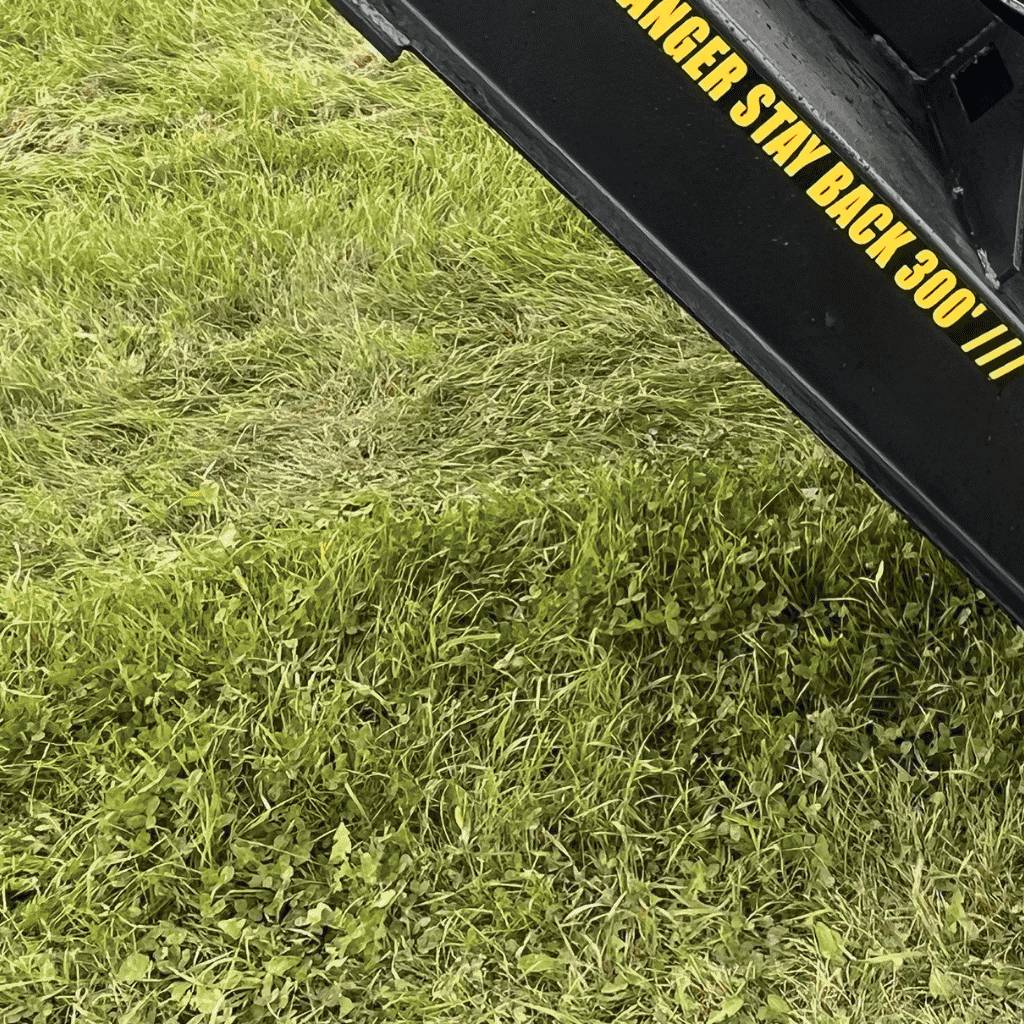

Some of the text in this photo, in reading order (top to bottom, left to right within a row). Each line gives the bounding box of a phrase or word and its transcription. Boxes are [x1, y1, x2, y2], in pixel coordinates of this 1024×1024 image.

[729, 84, 829, 174] STAY
[807, 163, 915, 268] BACK
[895, 249, 987, 328] 300'
